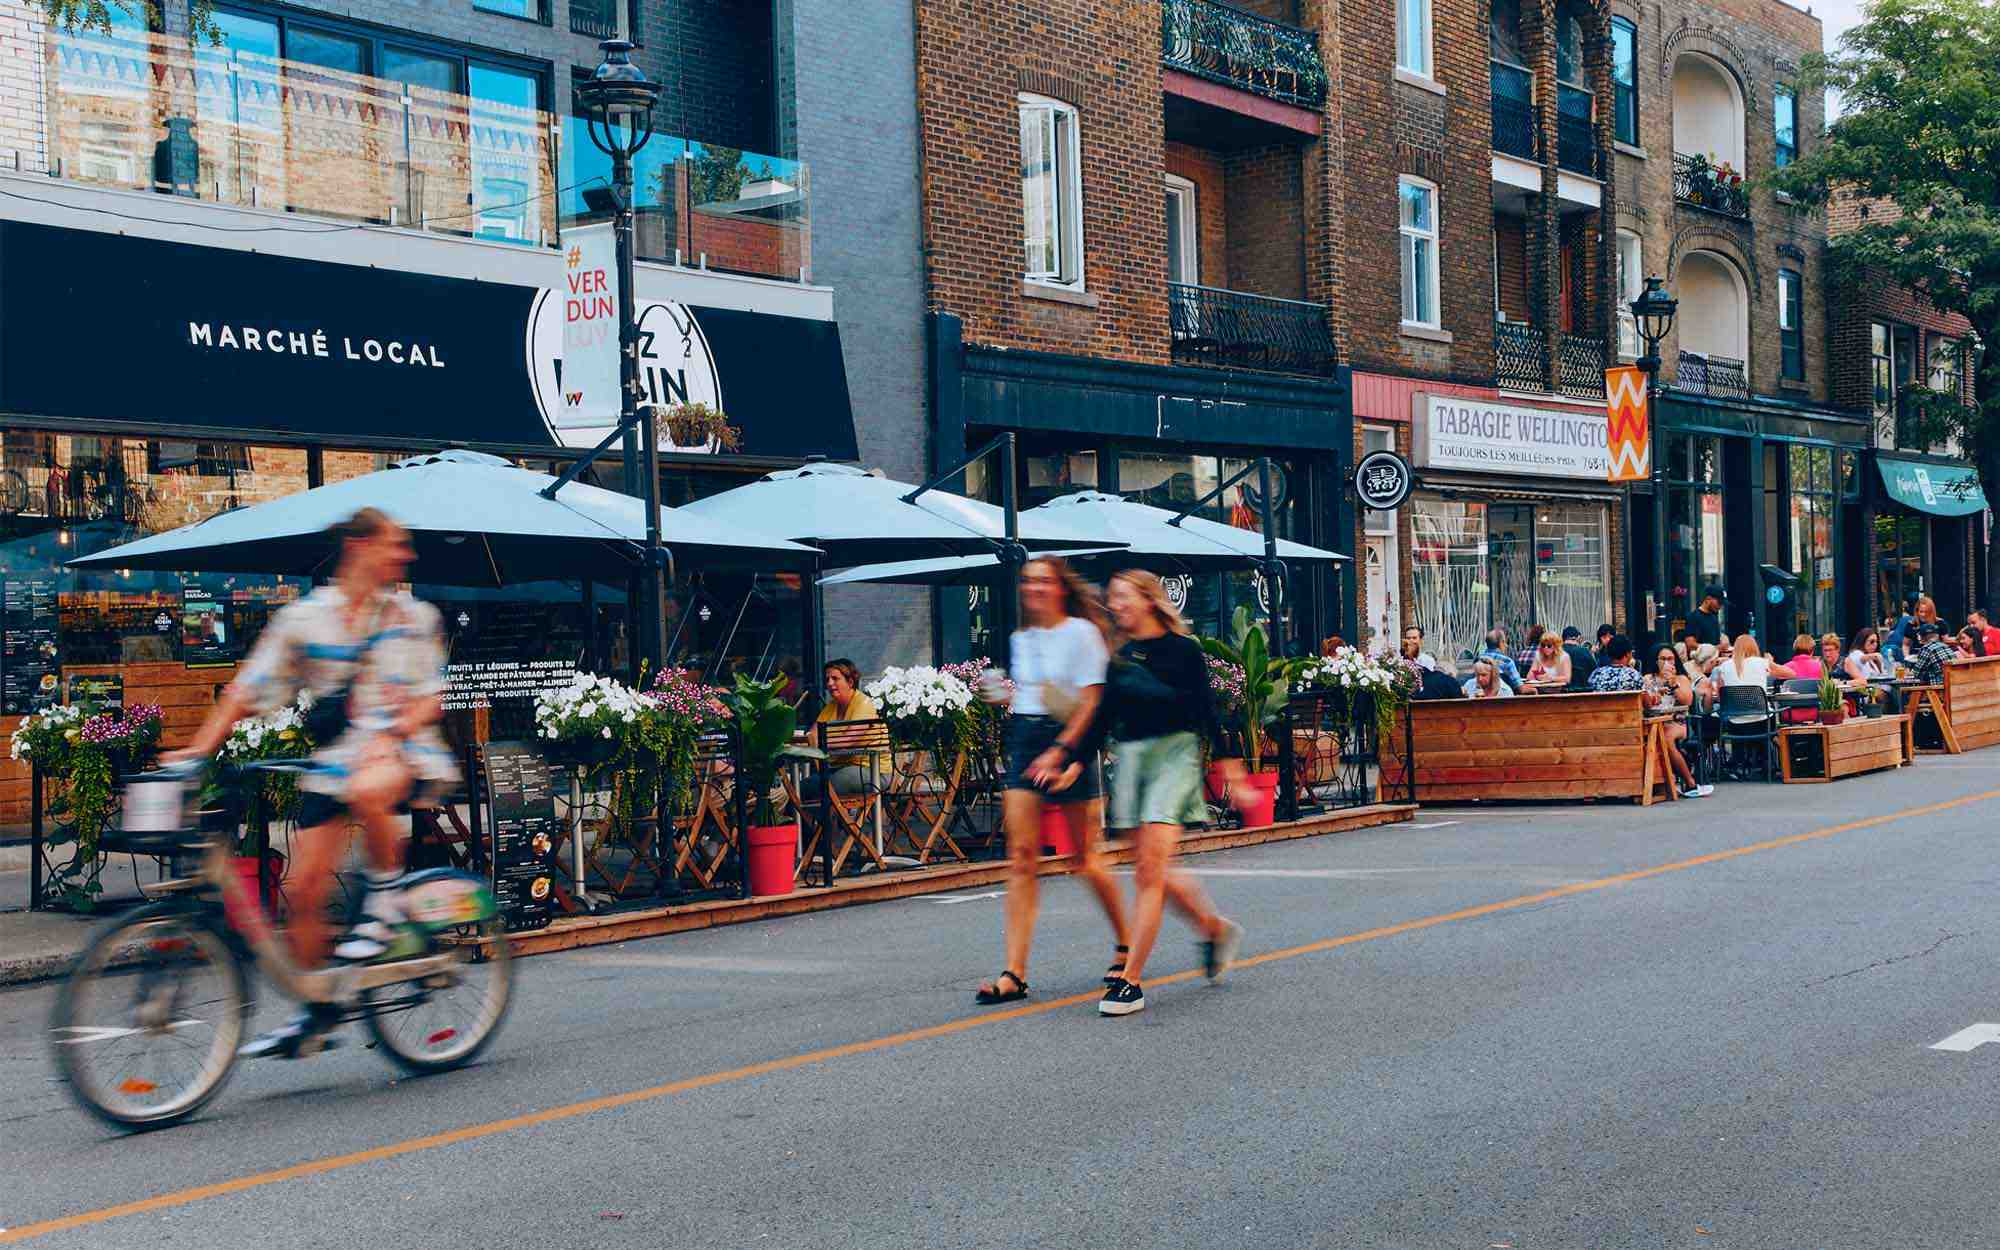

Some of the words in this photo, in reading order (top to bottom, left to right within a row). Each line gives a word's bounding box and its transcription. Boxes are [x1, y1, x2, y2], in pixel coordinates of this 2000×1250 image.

[567, 270, 608, 294] VER
[567, 296, 614, 322] DUN
[189, 321, 329, 357] MARCHÉ
[344, 337, 445, 367] LOCAL
[1436, 405, 1512, 440] TABAGIE
[1517, 415, 1608, 449] WELLINGTO
[1439, 445, 1488, 459] TOUJOURS
[1490, 447, 1506, 461] LES
[1508, 450, 1556, 465] MEILLEURS
[1584, 456, 1608, 471] 768-1
[447, 664, 473, 672] FRUITS
[475, 663, 485, 671] ET
[487, 661, 520, 671] LÉGUMES
[530, 660, 564, 669] PRODUITS
[565, 660, 576, 668] DU
[472, 672, 498, 681] VIANDE
[509, 669, 546, 679] PÂTURAGE
[453, 682, 473, 690] VRAC
[470, 690, 488, 699] FINS
[496, 690, 530, 699] PRODUITS
[441, 702, 467, 711] BISTRO
[468, 700, 493, 709] LOCAL
